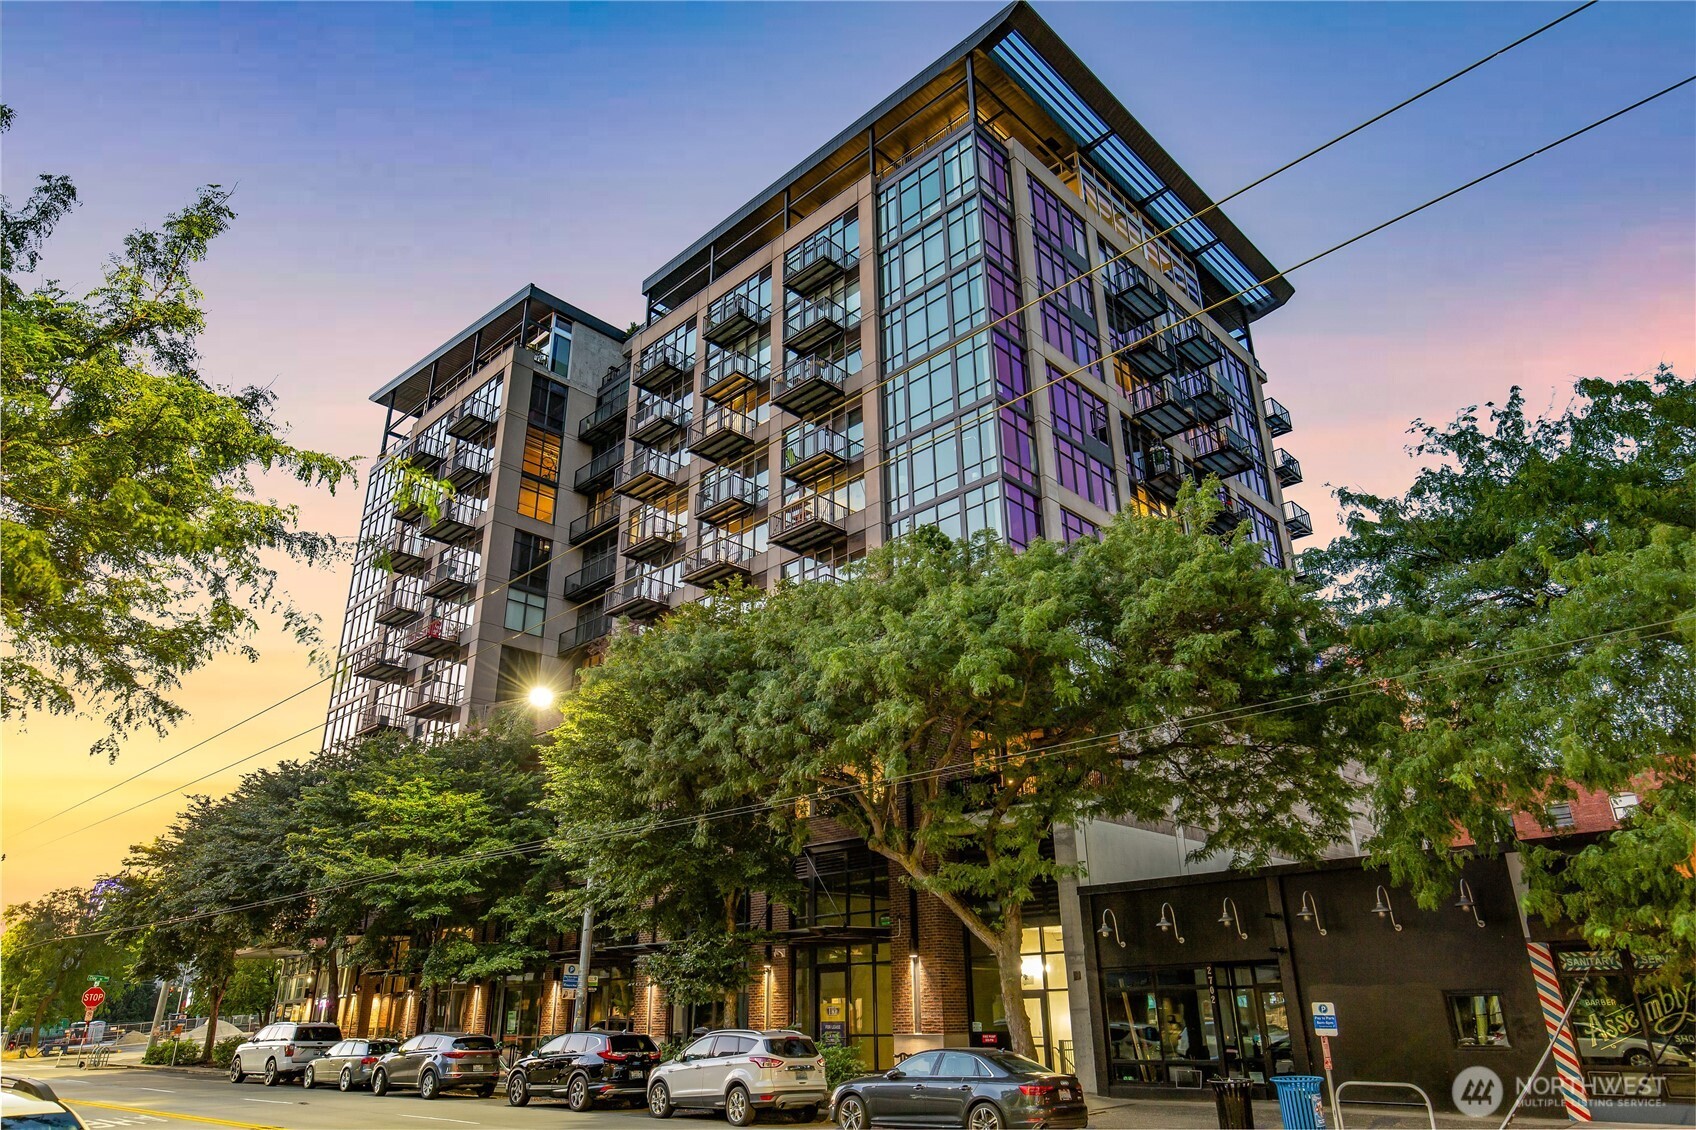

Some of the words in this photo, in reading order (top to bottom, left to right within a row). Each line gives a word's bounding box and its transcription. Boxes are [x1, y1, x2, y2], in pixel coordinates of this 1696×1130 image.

[1566, 956, 1615, 967] SANITARY
[1206, 966, 1216, 1004] 2702
[84, 994, 104, 1002] STOP
